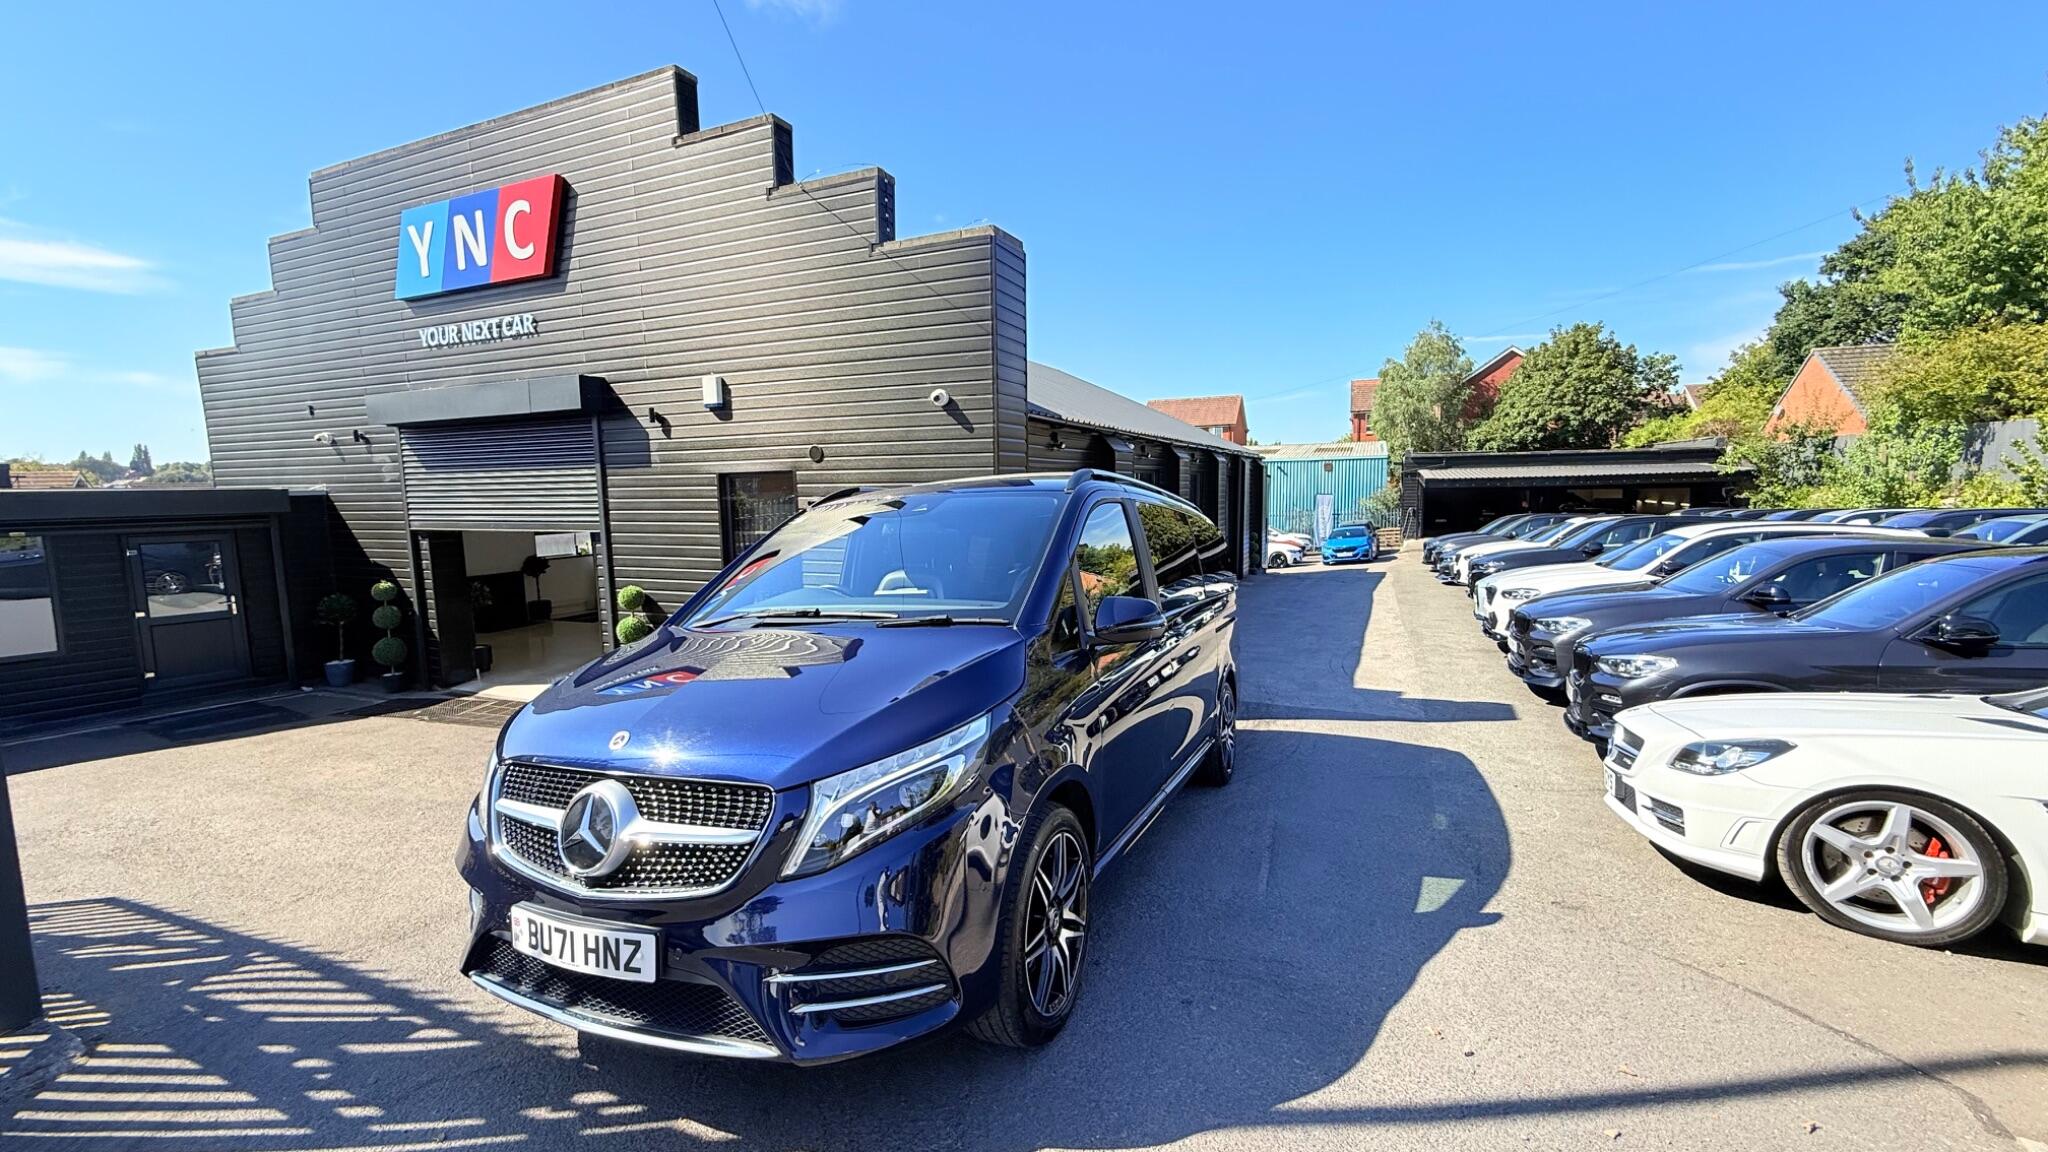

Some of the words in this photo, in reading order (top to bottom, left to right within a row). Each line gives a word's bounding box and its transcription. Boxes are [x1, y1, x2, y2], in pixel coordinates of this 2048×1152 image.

[407, 199, 535, 278] YNC
[419, 325, 460, 347] YOUR
[461, 319, 500, 342] NEXT
[501, 313, 536, 337] CAR
[527, 917, 575, 963] BU71
[583, 933, 642, 974] HNZ
